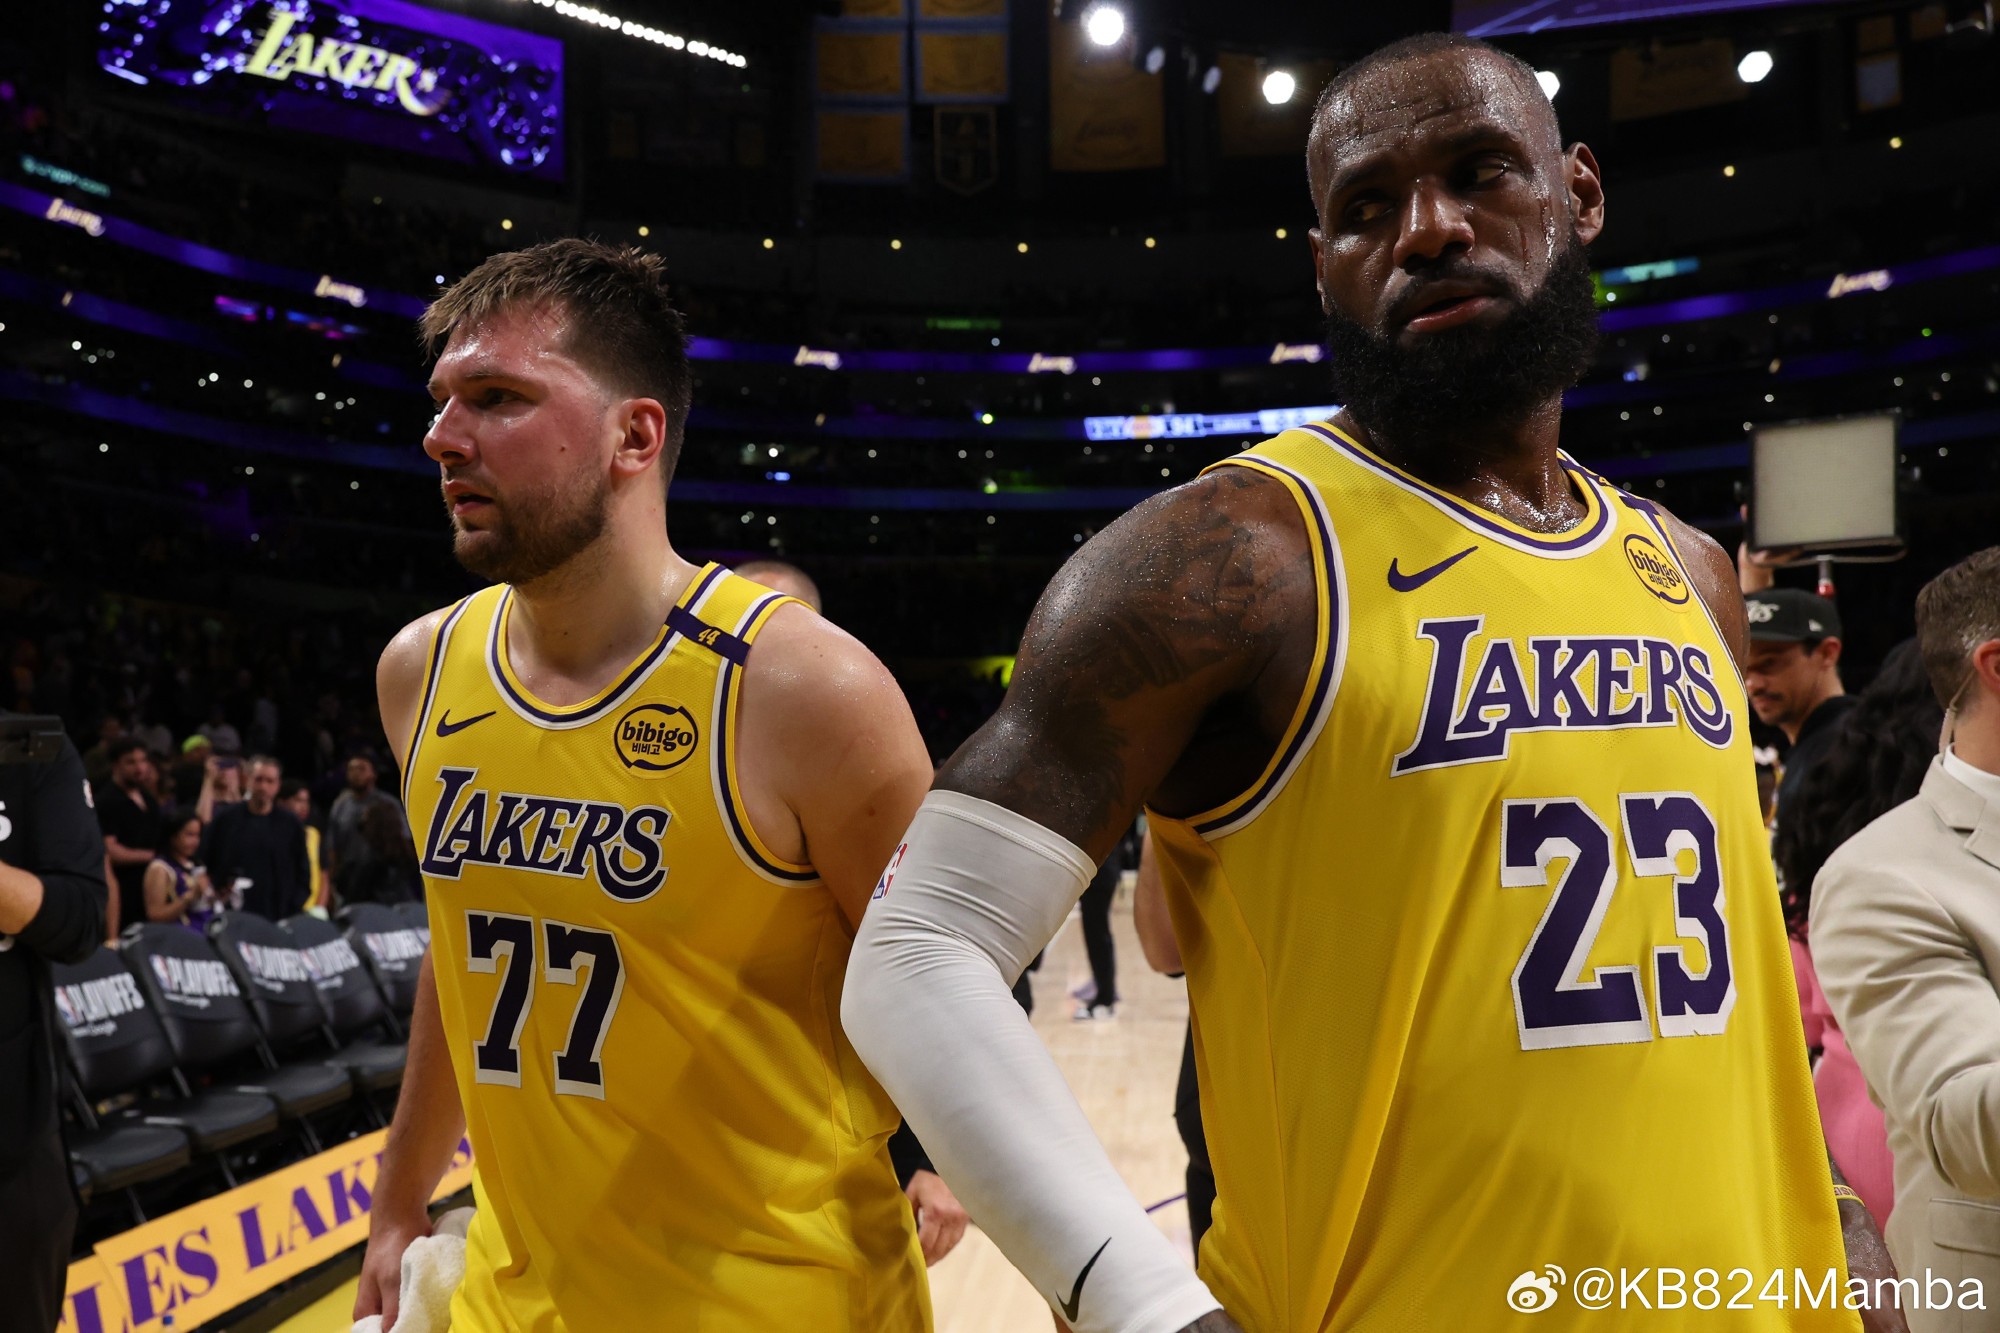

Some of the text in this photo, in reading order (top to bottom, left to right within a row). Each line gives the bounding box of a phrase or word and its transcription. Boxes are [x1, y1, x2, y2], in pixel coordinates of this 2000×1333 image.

[1628, 548, 1681, 588] bibigo
[699, 628, 722, 646] 44
[622, 720, 693, 752] bibigo
[632, 743, 661, 755] 비비고
[1390, 613, 1734, 778] LAKERS
[420, 766, 672, 904] LAKERS
[1501, 791, 1737, 1051] 23
[464, 909, 627, 1101] 77
[57, 1226, 220, 1333] LES
